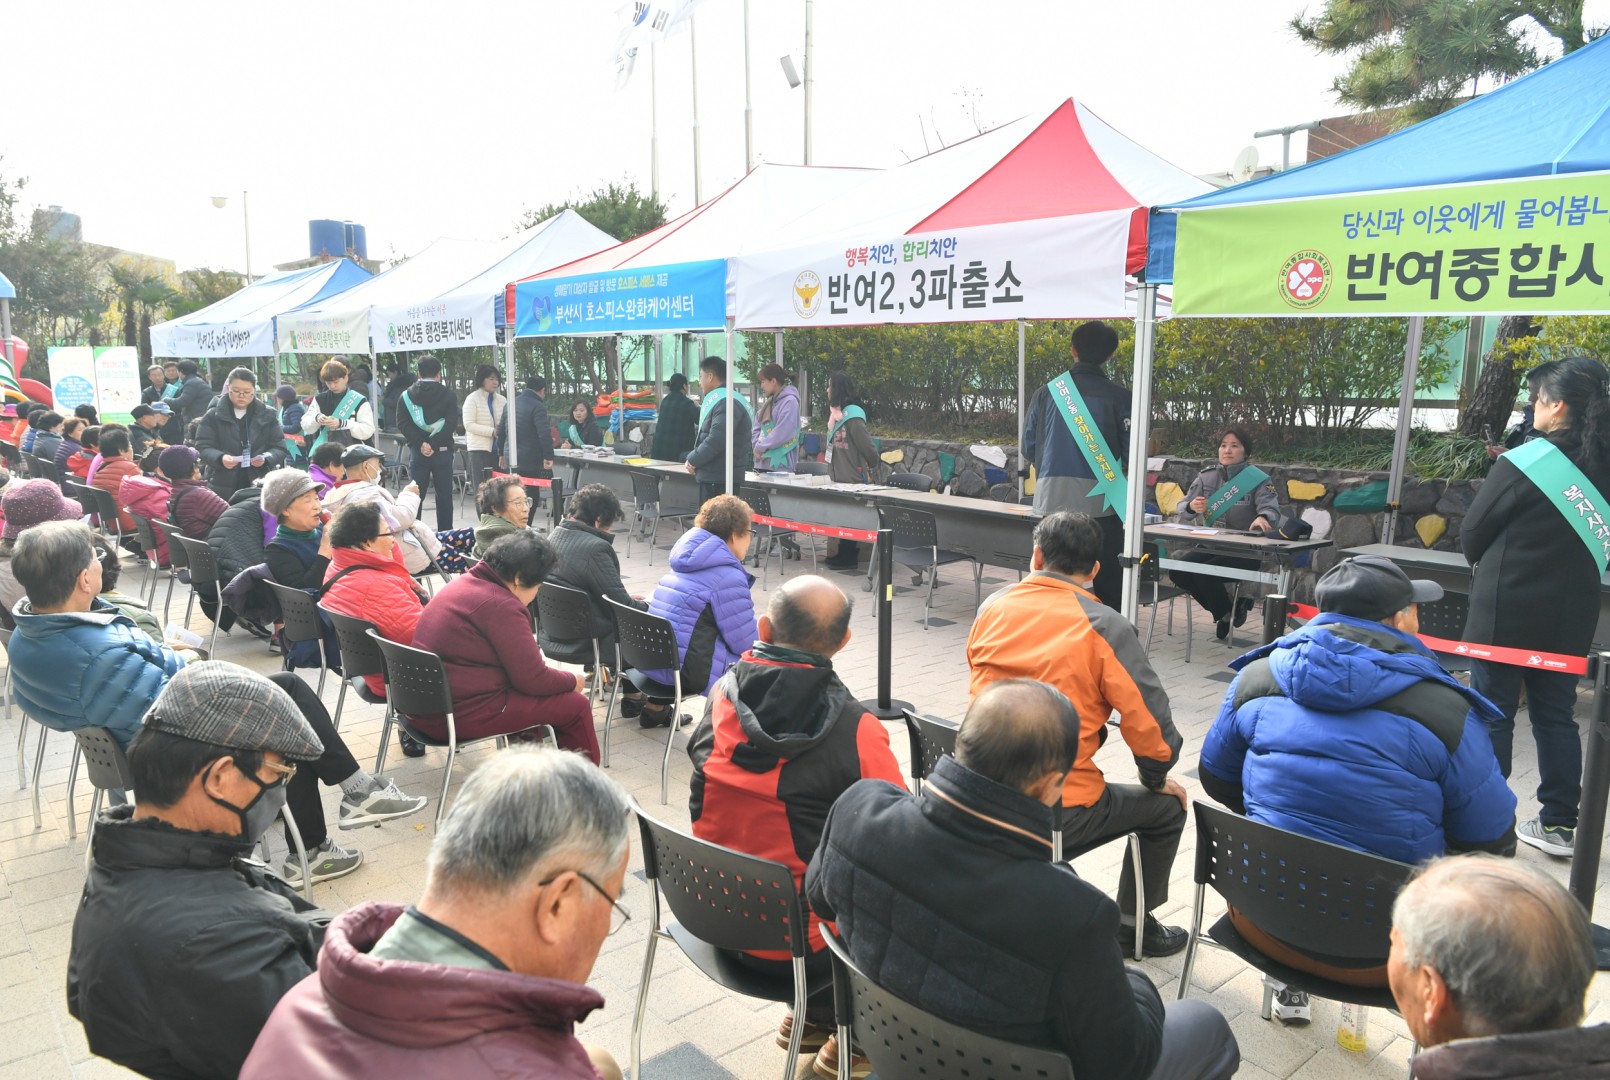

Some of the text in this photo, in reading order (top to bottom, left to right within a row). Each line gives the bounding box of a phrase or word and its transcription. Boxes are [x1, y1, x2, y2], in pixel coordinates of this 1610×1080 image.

[1343, 207, 1404, 239] 당신과
[1413, 200, 1505, 234] 이웃에게
[845, 237, 958, 268] 행복치안, 합리치안
[606, 278, 616, 292] 방문
[618, 275, 638, 291] 호스피스
[639, 274, 656, 289] 서비스
[656, 273, 668, 287] 제공
[828, 260, 1024, 315] 반여2,3파출소
[555, 294, 695, 325] 부산시 호스피스완화케어센터
[397, 317, 474, 345] 반여2동 행정복지센터
[1073, 414, 1100, 453] 찾아가는
[1562, 484, 1610, 561] 복지사각
